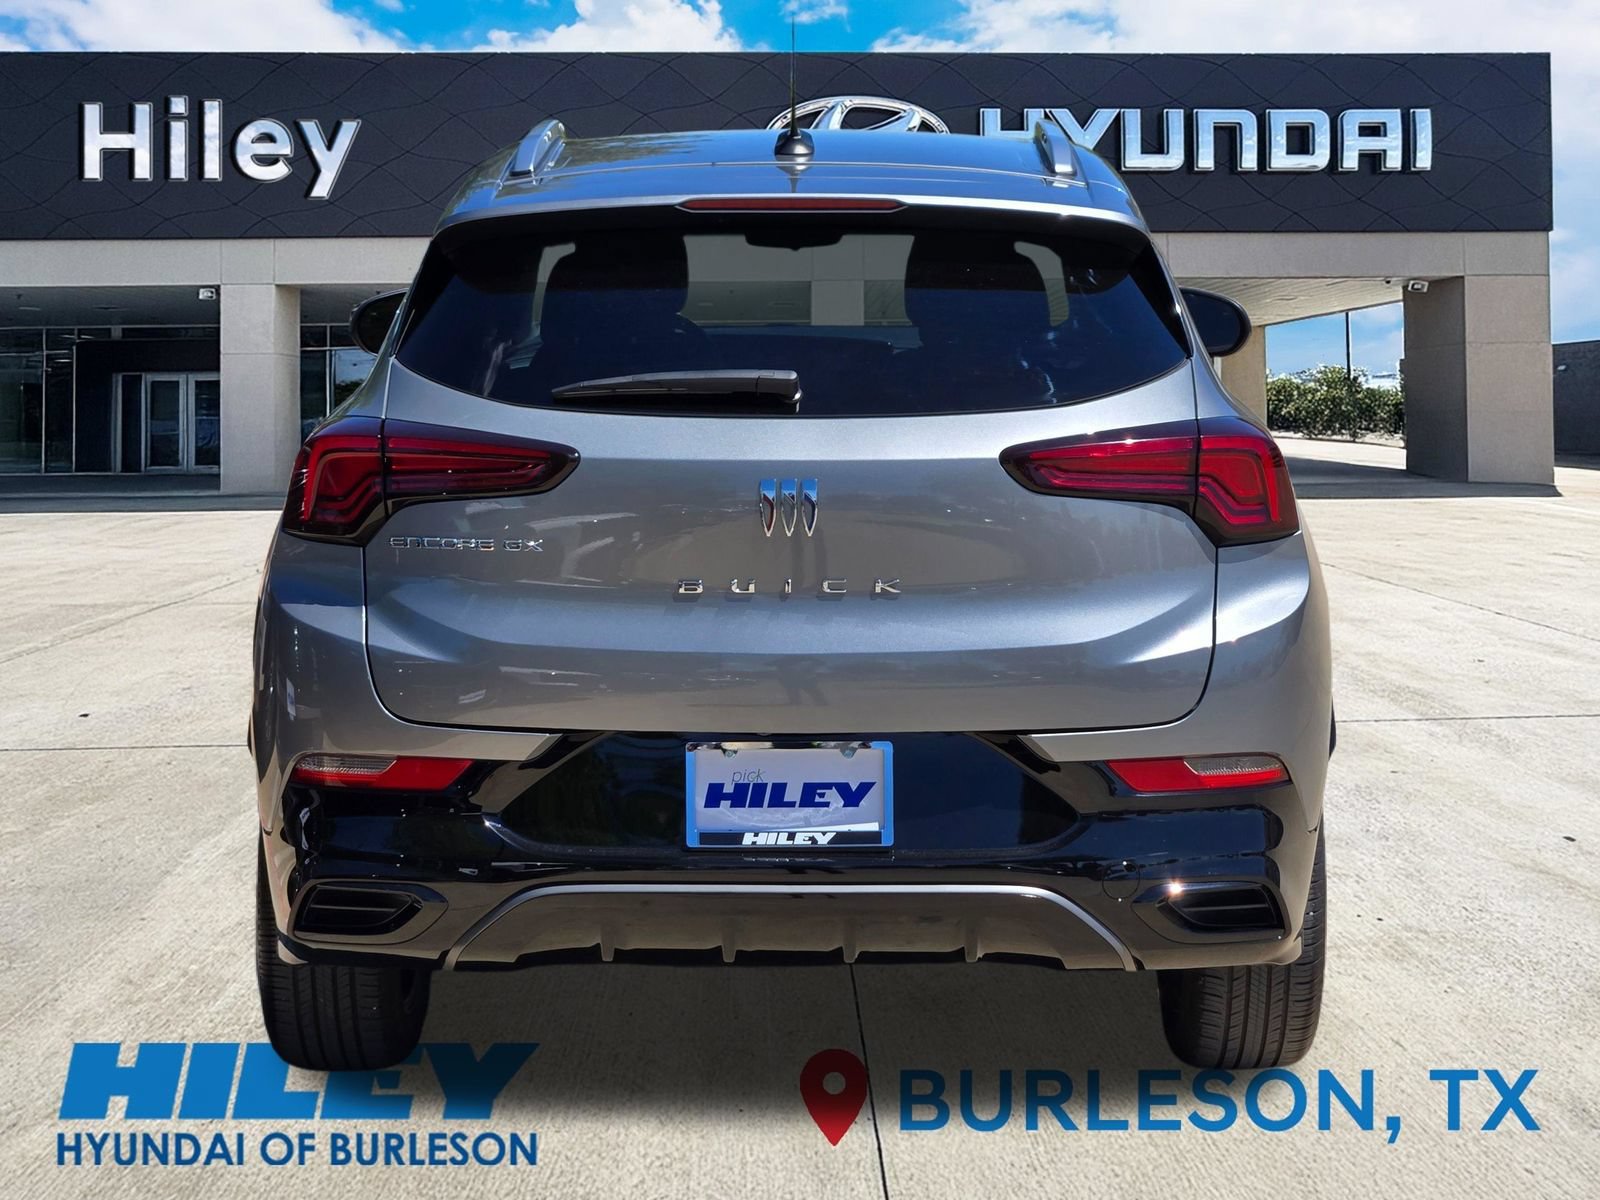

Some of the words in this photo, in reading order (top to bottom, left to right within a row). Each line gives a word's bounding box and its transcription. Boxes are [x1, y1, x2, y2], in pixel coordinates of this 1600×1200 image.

[80, 95, 362, 200] Hiley
[390, 537, 494, 550] ENCORE
[504, 539, 543, 552] GX
[678, 578, 901, 594] BUICK
[731, 768, 765, 784] pick
[703, 781, 877, 808] HILEY
[742, 832, 837, 845] HILEY
